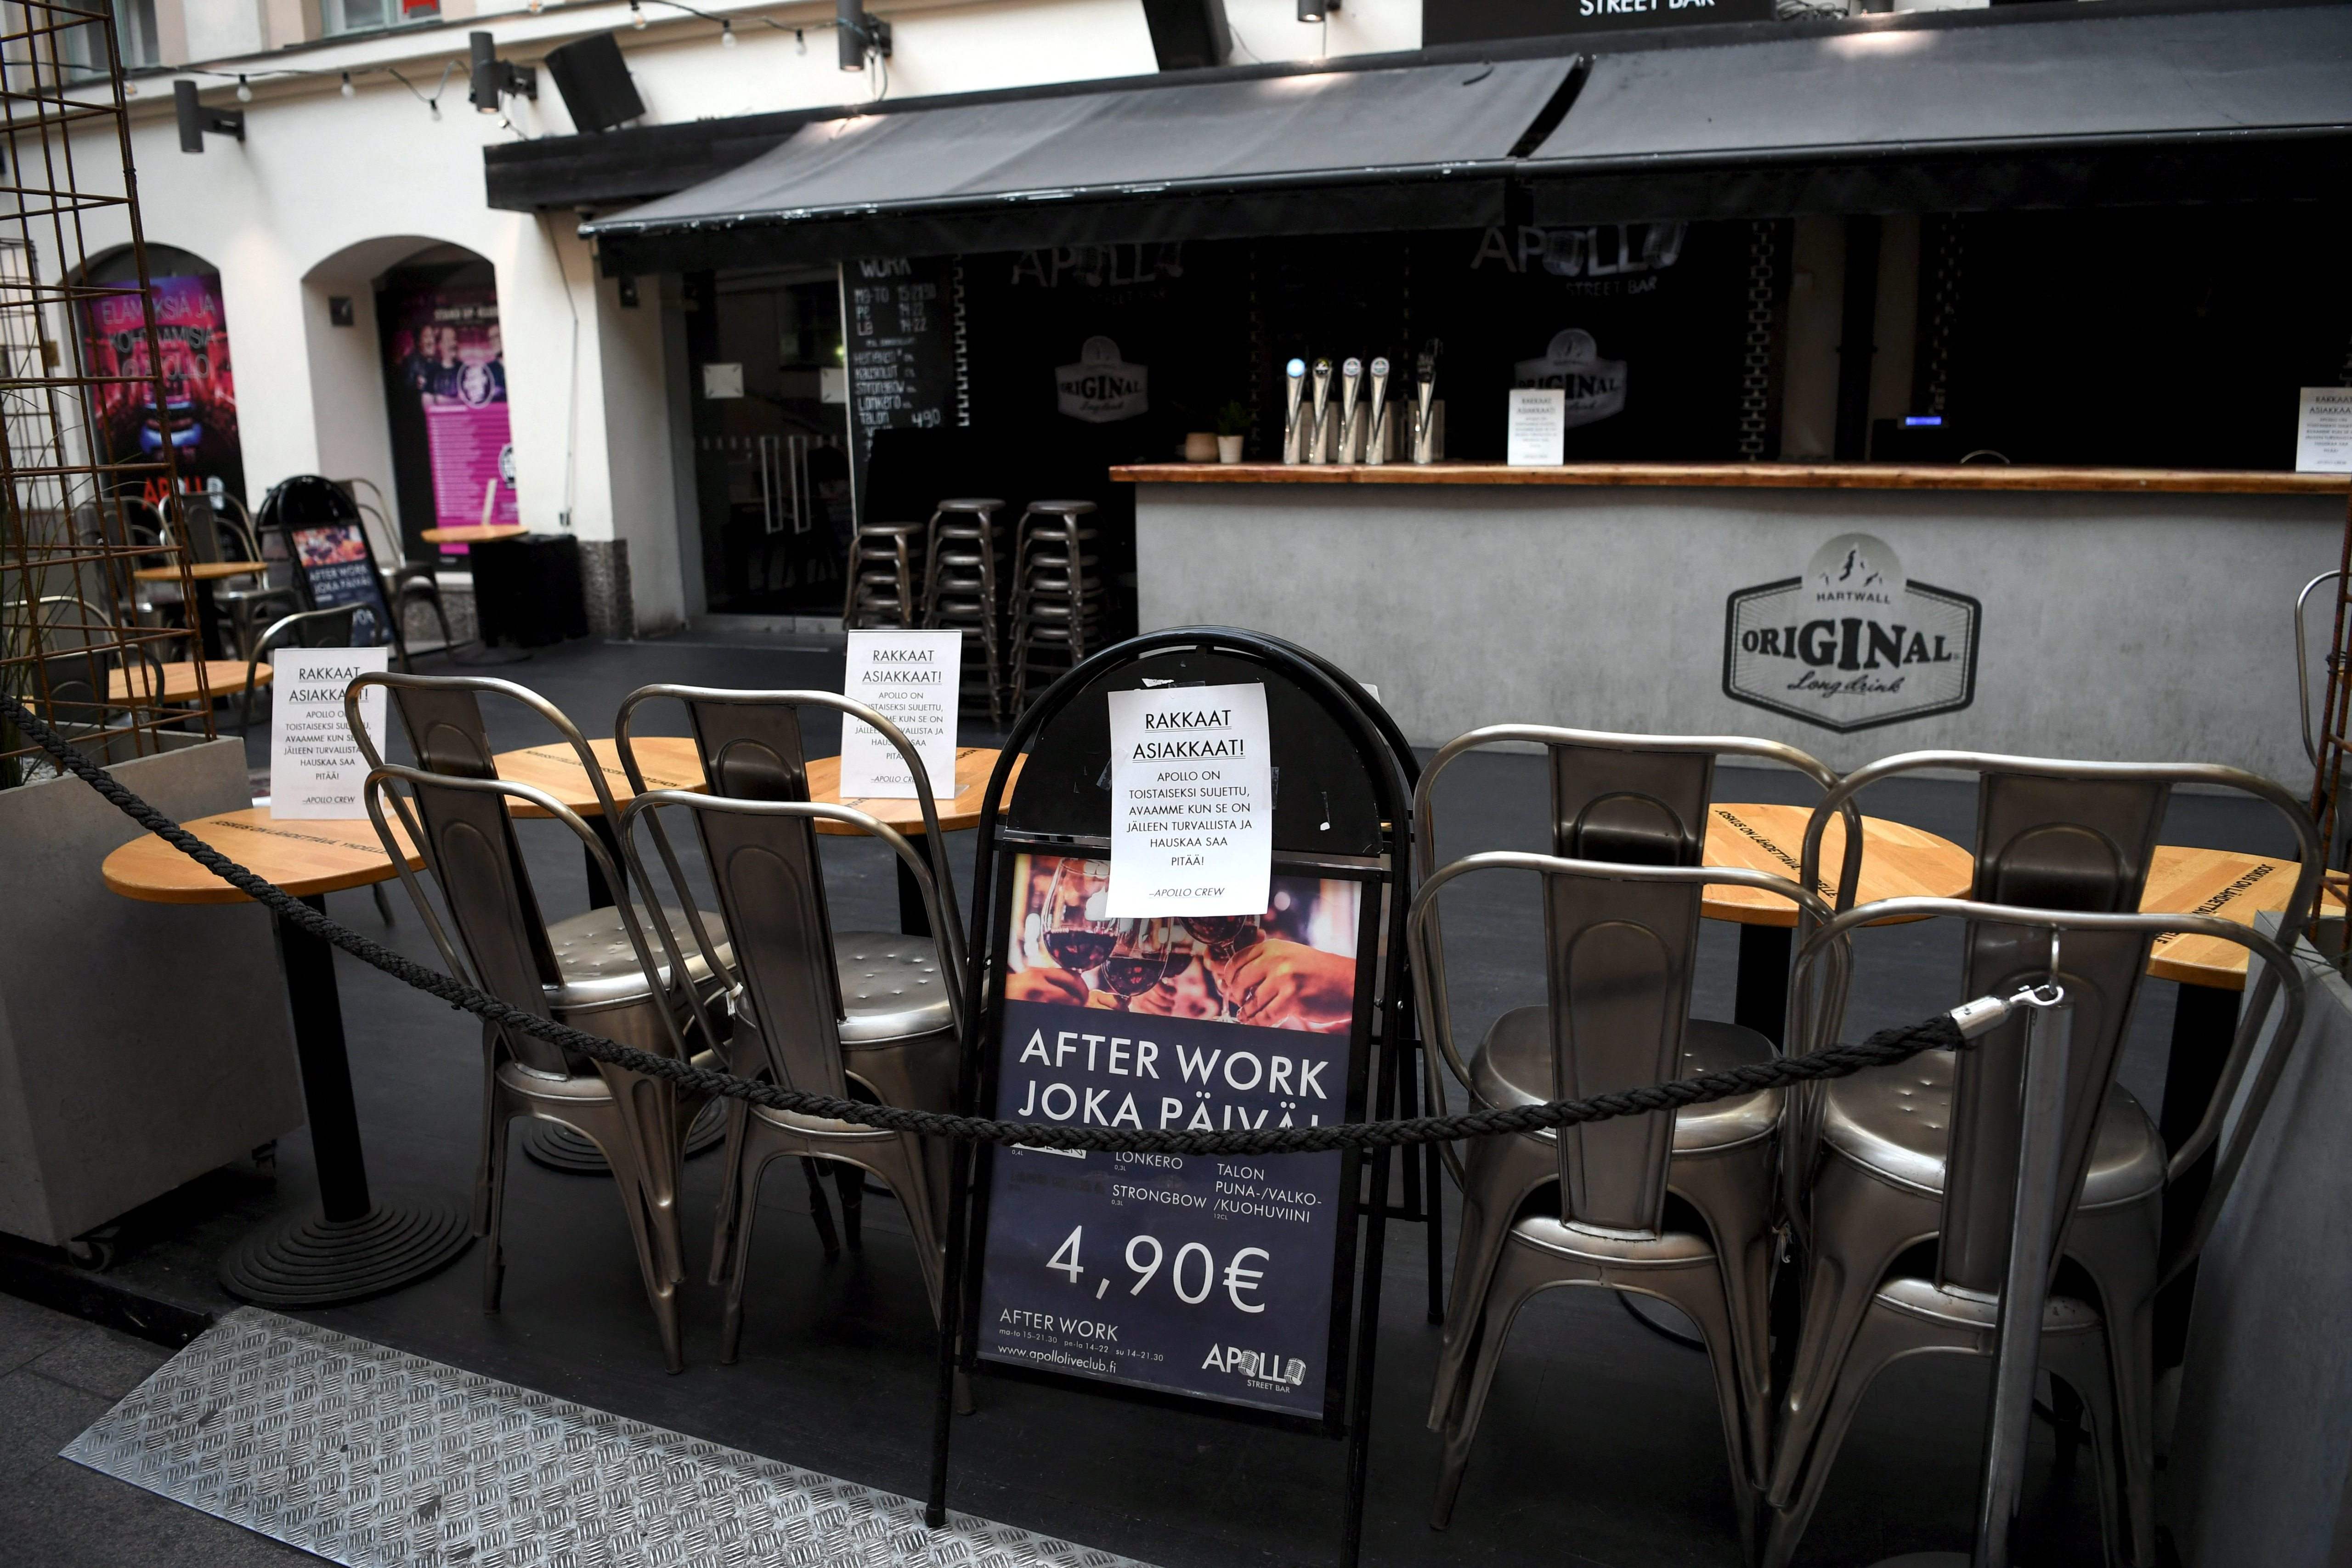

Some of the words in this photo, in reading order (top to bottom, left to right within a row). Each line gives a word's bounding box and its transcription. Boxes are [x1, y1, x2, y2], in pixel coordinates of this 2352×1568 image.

[1816, 592, 1891, 605] HARTWALL
[1742, 617, 1952, 671] ORIGINAL
[873, 650, 935, 662] RAKKAAT
[299, 667, 361, 680] RAKKAAT
[862, 671, 942, 683] ASIAKKAAT!
[289, 688, 368, 702] ASIAKKAT!
[286, 723, 334, 731] TOISTAISEKSI
[336, 722, 371, 730] SULU,
[1146, 710, 1232, 729] RAKKAAT
[284, 746, 313, 755] JÄLLEEN
[316, 746, 362, 754] TURVALLISTA
[886, 752, 905, 760] PITÄ
[1132, 739, 1244, 759] ASIAKKAAT!
[316, 771, 339, 780] PITÄÄ!
[1157, 771, 1199, 782] APOLLO
[1201, 770, 1221, 781] ON
[1129, 788, 1197, 799] TOISTAISEKSI
[1200, 786, 1250, 798] SULJETTU,
[1129, 805, 1184, 816] AVAAMME
[1188, 804, 1211, 815] KUN
[1216, 804, 1228, 814] SE
[1231, 803, 1250, 813] ON
[1126, 820, 1168, 833] JÄLLEEN
[1172, 820, 1237, 831] TURVALLISTA
[1239, 819, 1252, 830] JA
[1714, 809, 1746, 828] JOSKUS
[1739, 827, 1758, 836] ON
[1150, 837, 1202, 848] HAUSKAA
[1206, 837, 1228, 847] SAA
[1171, 854, 1204, 866] PITÄÄ!
[2241, 864, 2276, 882] JOSKUS
[1195, 887, 1225, 896] CREW
[2231, 880, 2252, 890] ON
[2190, 886, 2242, 915] LÄHDETTÄV
[1018, 1027, 1160, 1080] AFTER
[1176, 1044, 1329, 1100] WORK
[1018, 1080, 1143, 1131] JOKA
[1115, 1151, 1183, 1170] LONKERO
[1217, 1163, 1265, 1181] TALON
[1112, 1184, 1207, 1210] STRONGBOW
[1215, 1181, 1323, 1207] PUNA-/VALKO-
[1213, 1198, 1311, 1224] /KUOHUVIINI
[1046, 1224, 1271, 1314] 4,90€
[999, 1308, 1054, 1331] AFTER
[1059, 1316, 1119, 1342] WORK
[999, 1328, 1021, 1337] ma-to
[1064, 1339, 1083, 1349] pe-la
[998, 1344, 1117, 1374] www.apolloliveclub.fi
[1201, 1342, 1306, 1387] APOLLO
[1247, 1379, 1274, 1392] STREET
[1275, 1383, 1291, 1394] BAR
